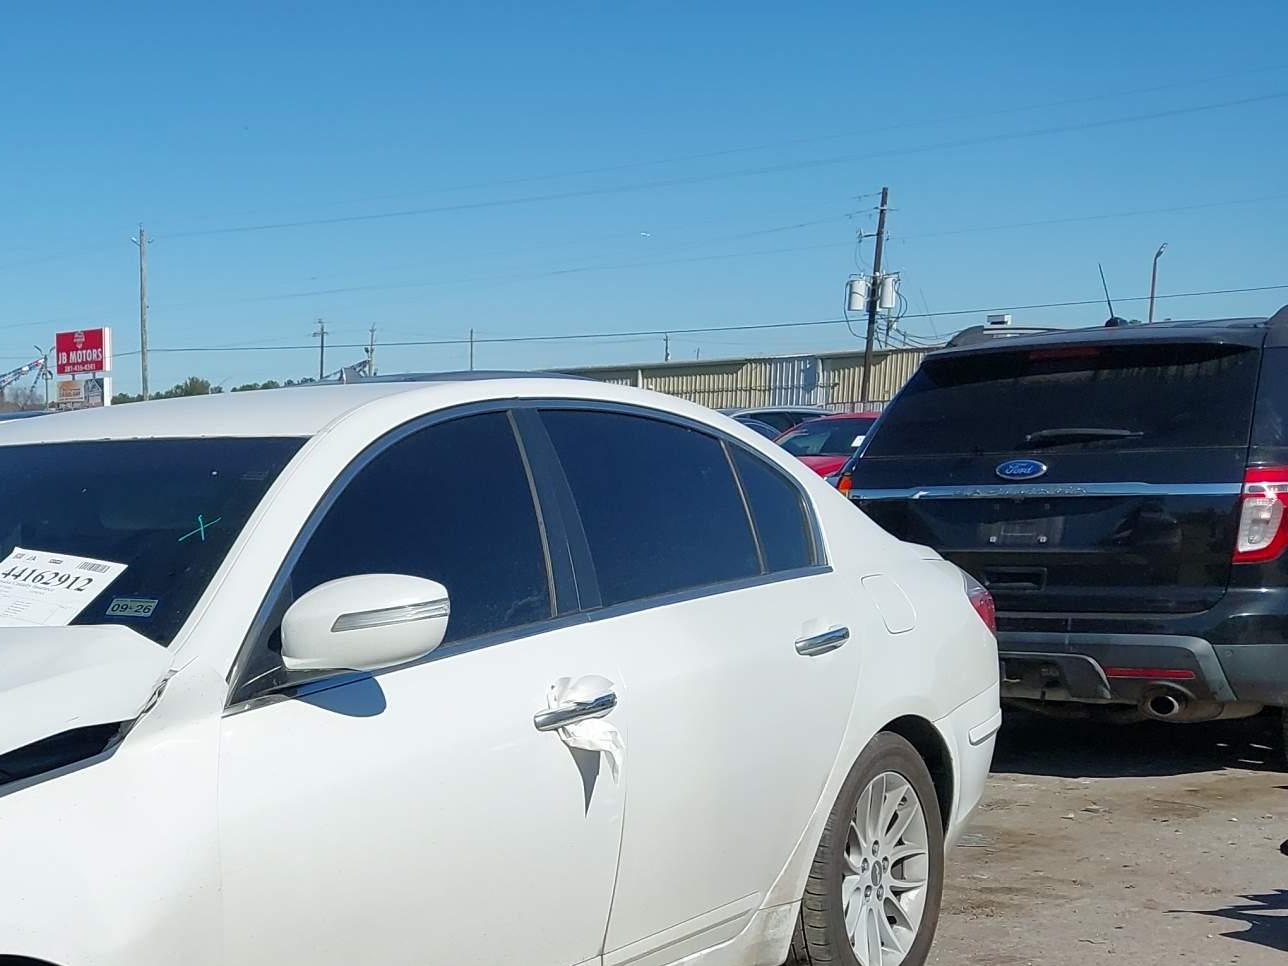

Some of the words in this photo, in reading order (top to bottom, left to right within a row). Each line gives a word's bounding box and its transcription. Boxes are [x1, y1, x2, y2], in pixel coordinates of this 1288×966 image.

[58, 352, 67, 365] JB
[69, 349, 103, 363] MOTORS
[1, 565, 94, 592] 44162912
[111, 603, 153, 614] 09-26
